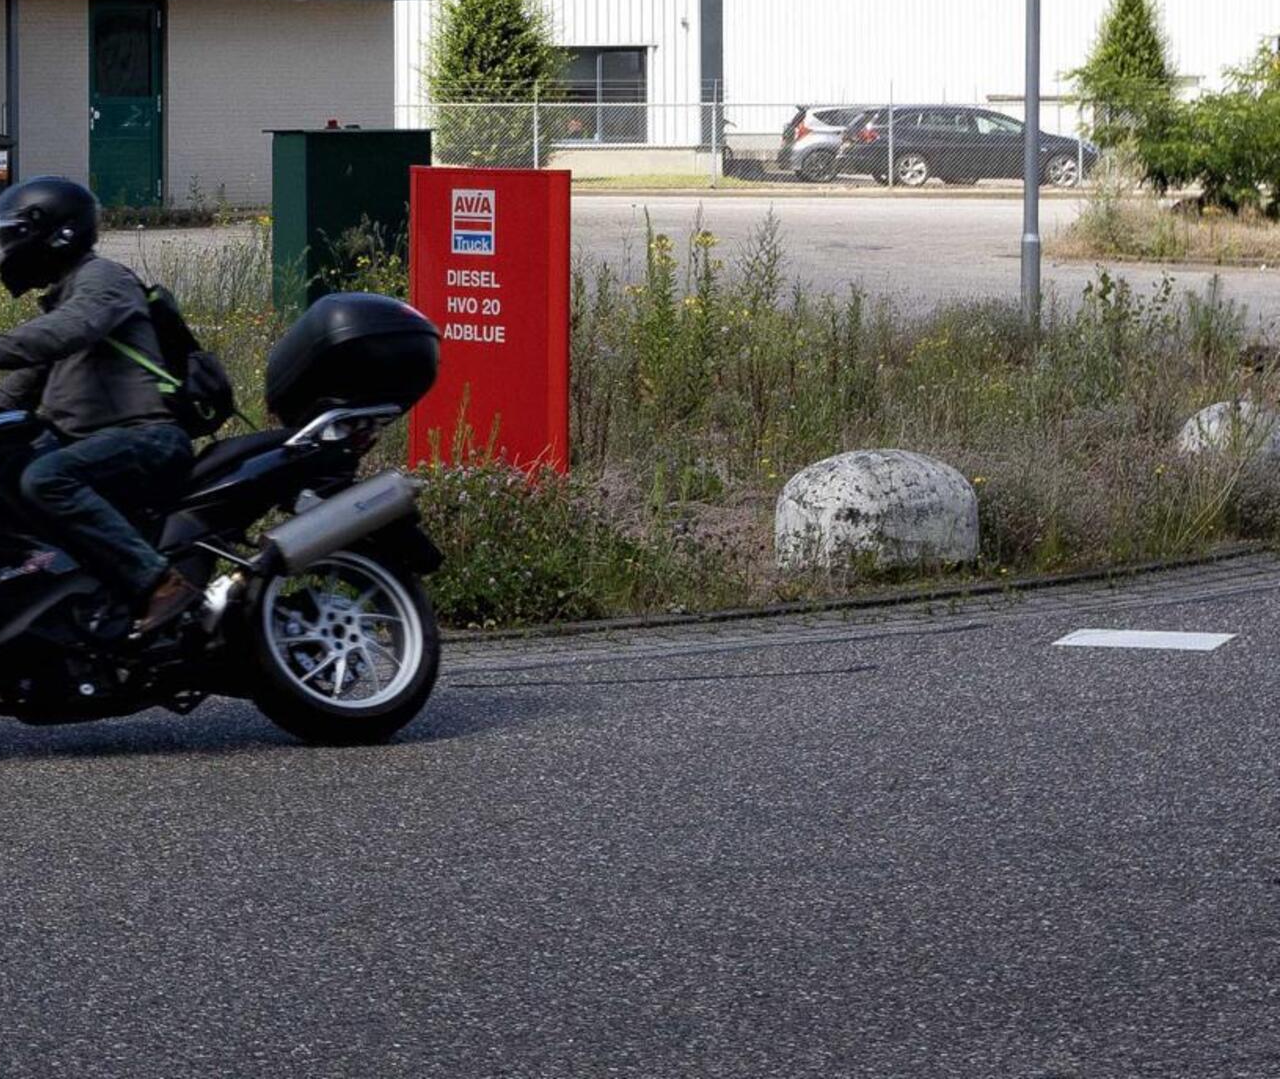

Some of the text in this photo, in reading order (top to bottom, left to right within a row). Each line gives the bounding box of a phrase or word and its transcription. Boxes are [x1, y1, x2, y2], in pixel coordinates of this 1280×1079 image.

[455, 236, 490, 252] Truck
[447, 270, 501, 288] DIESEL
[447, 297, 501, 315] HVO 20
[443, 323, 506, 342] ADBLUE
